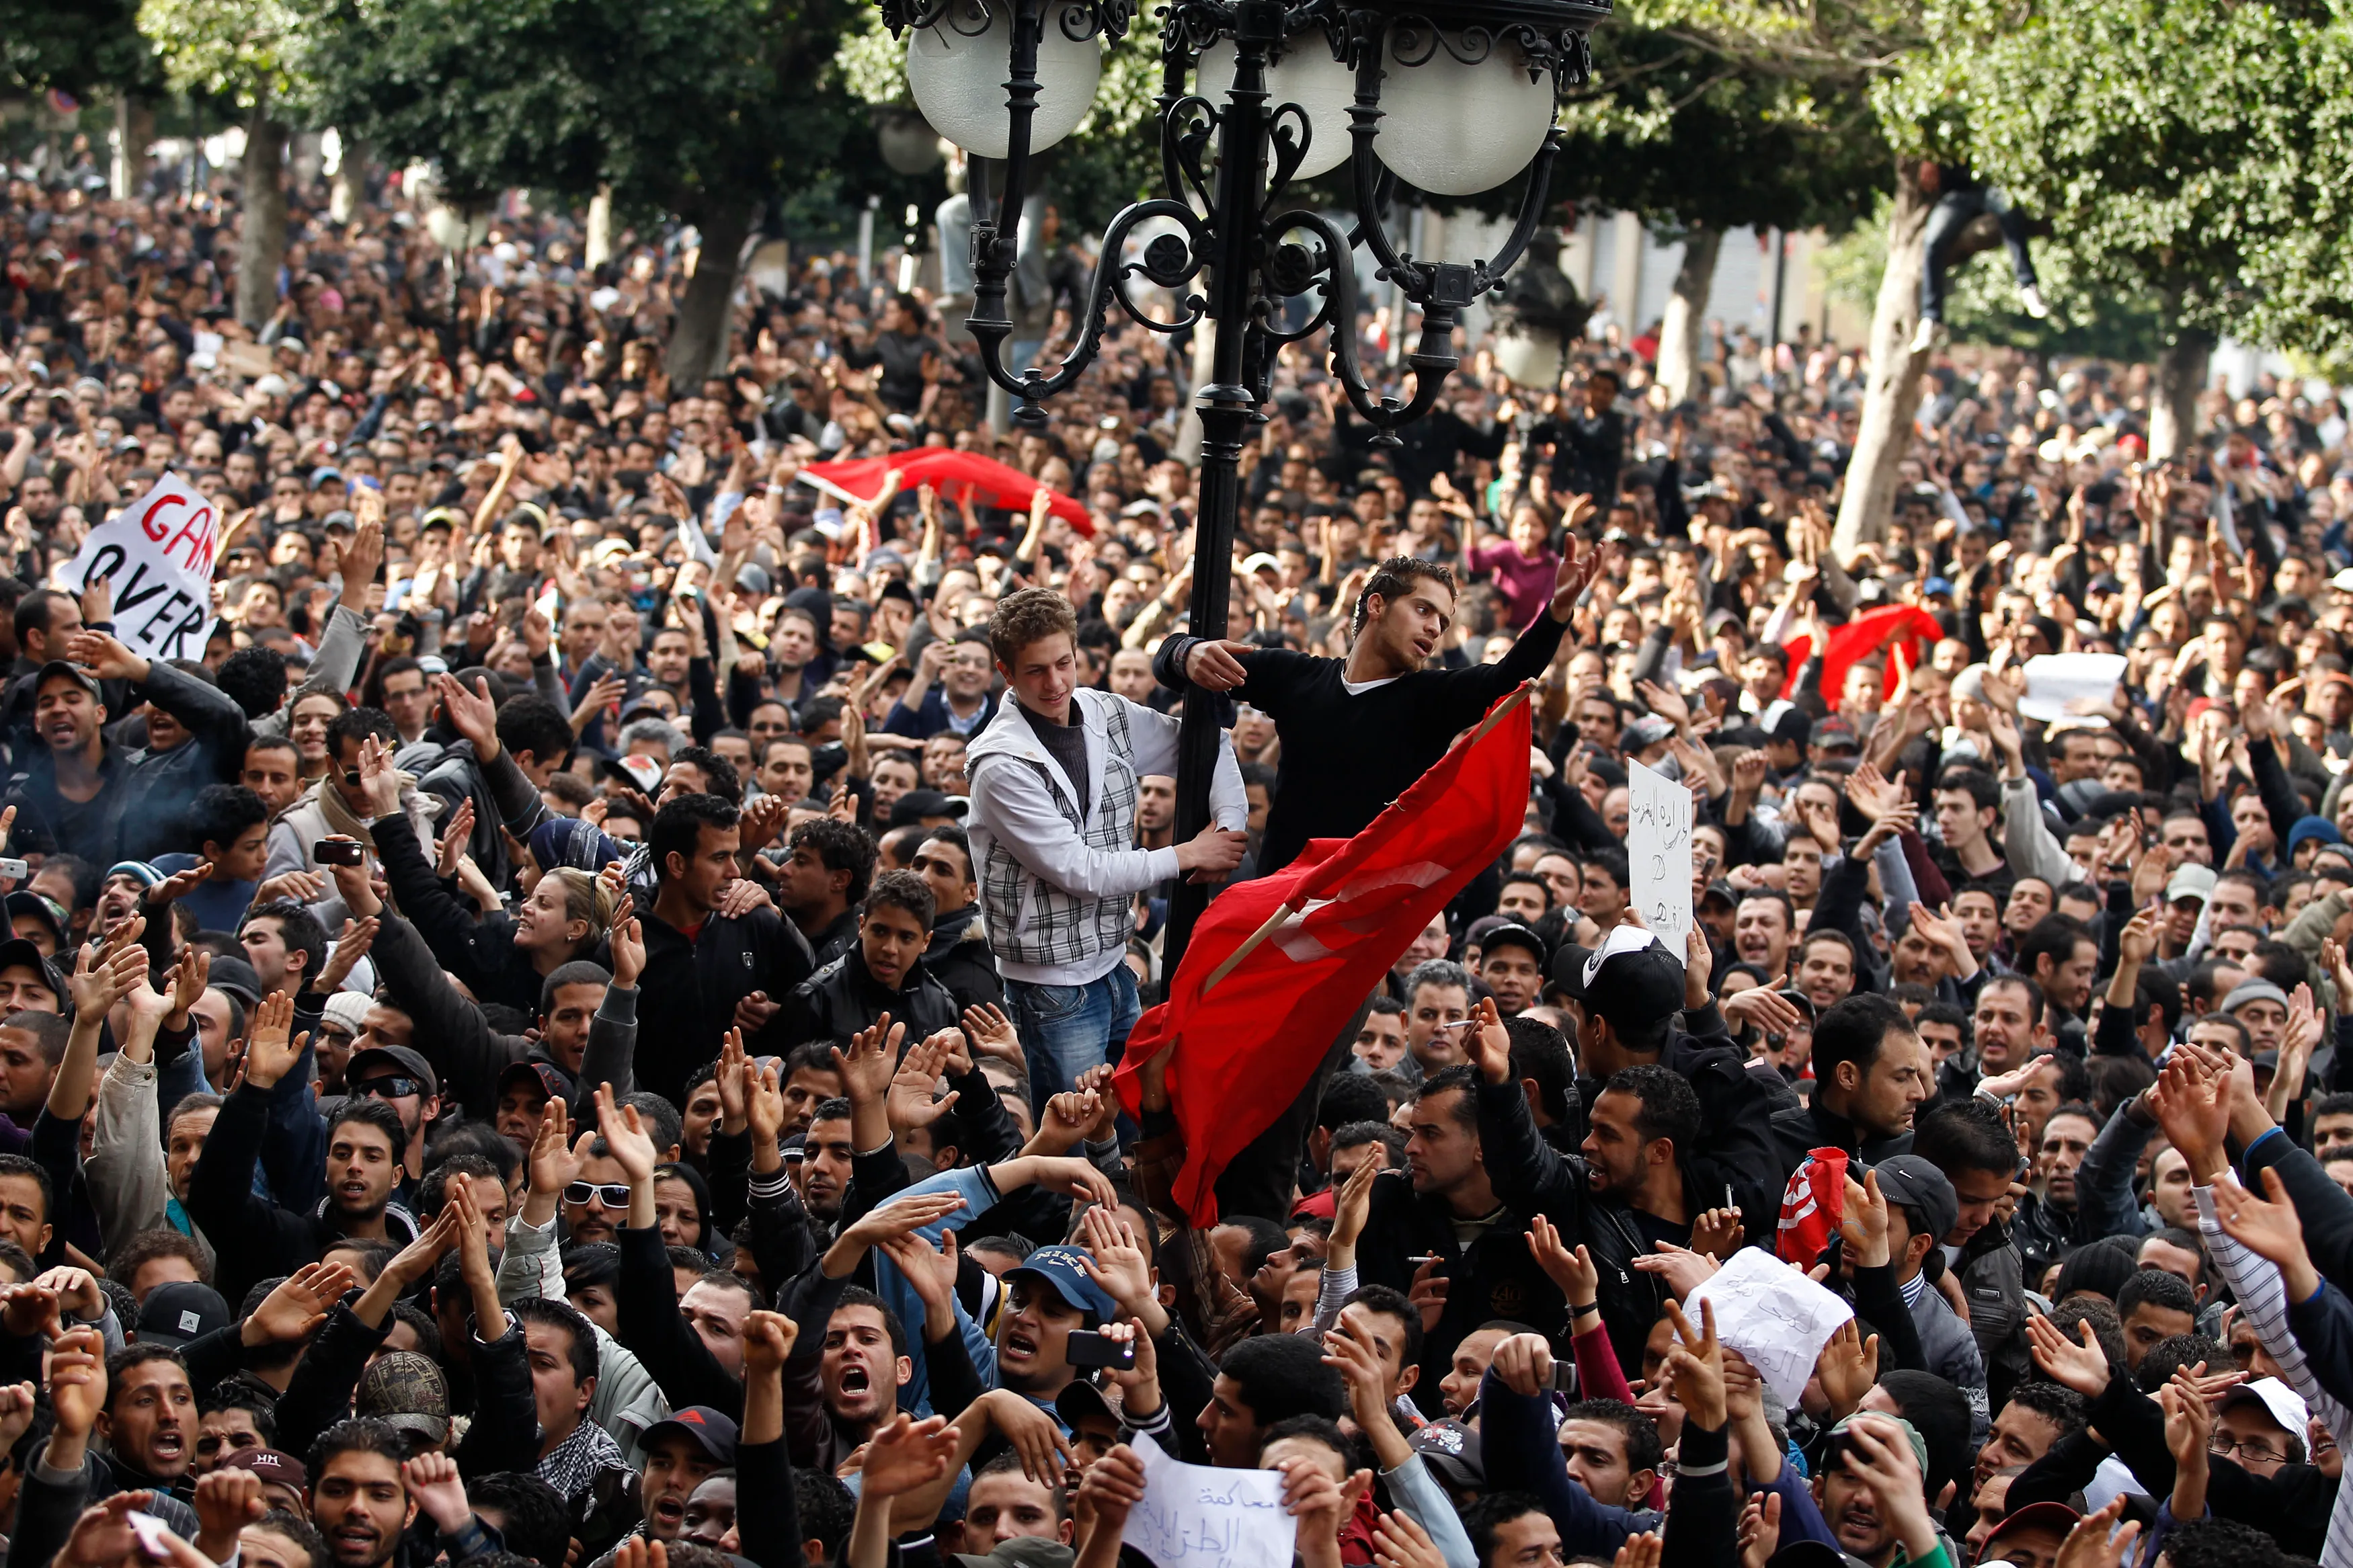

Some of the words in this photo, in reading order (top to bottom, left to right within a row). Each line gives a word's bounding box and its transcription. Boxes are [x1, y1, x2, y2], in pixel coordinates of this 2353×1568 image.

[83, 544, 206, 659] OVER
[1035, 1250, 1088, 1278] NIKE
[1197, 1480, 1275, 1508] محاكمة
